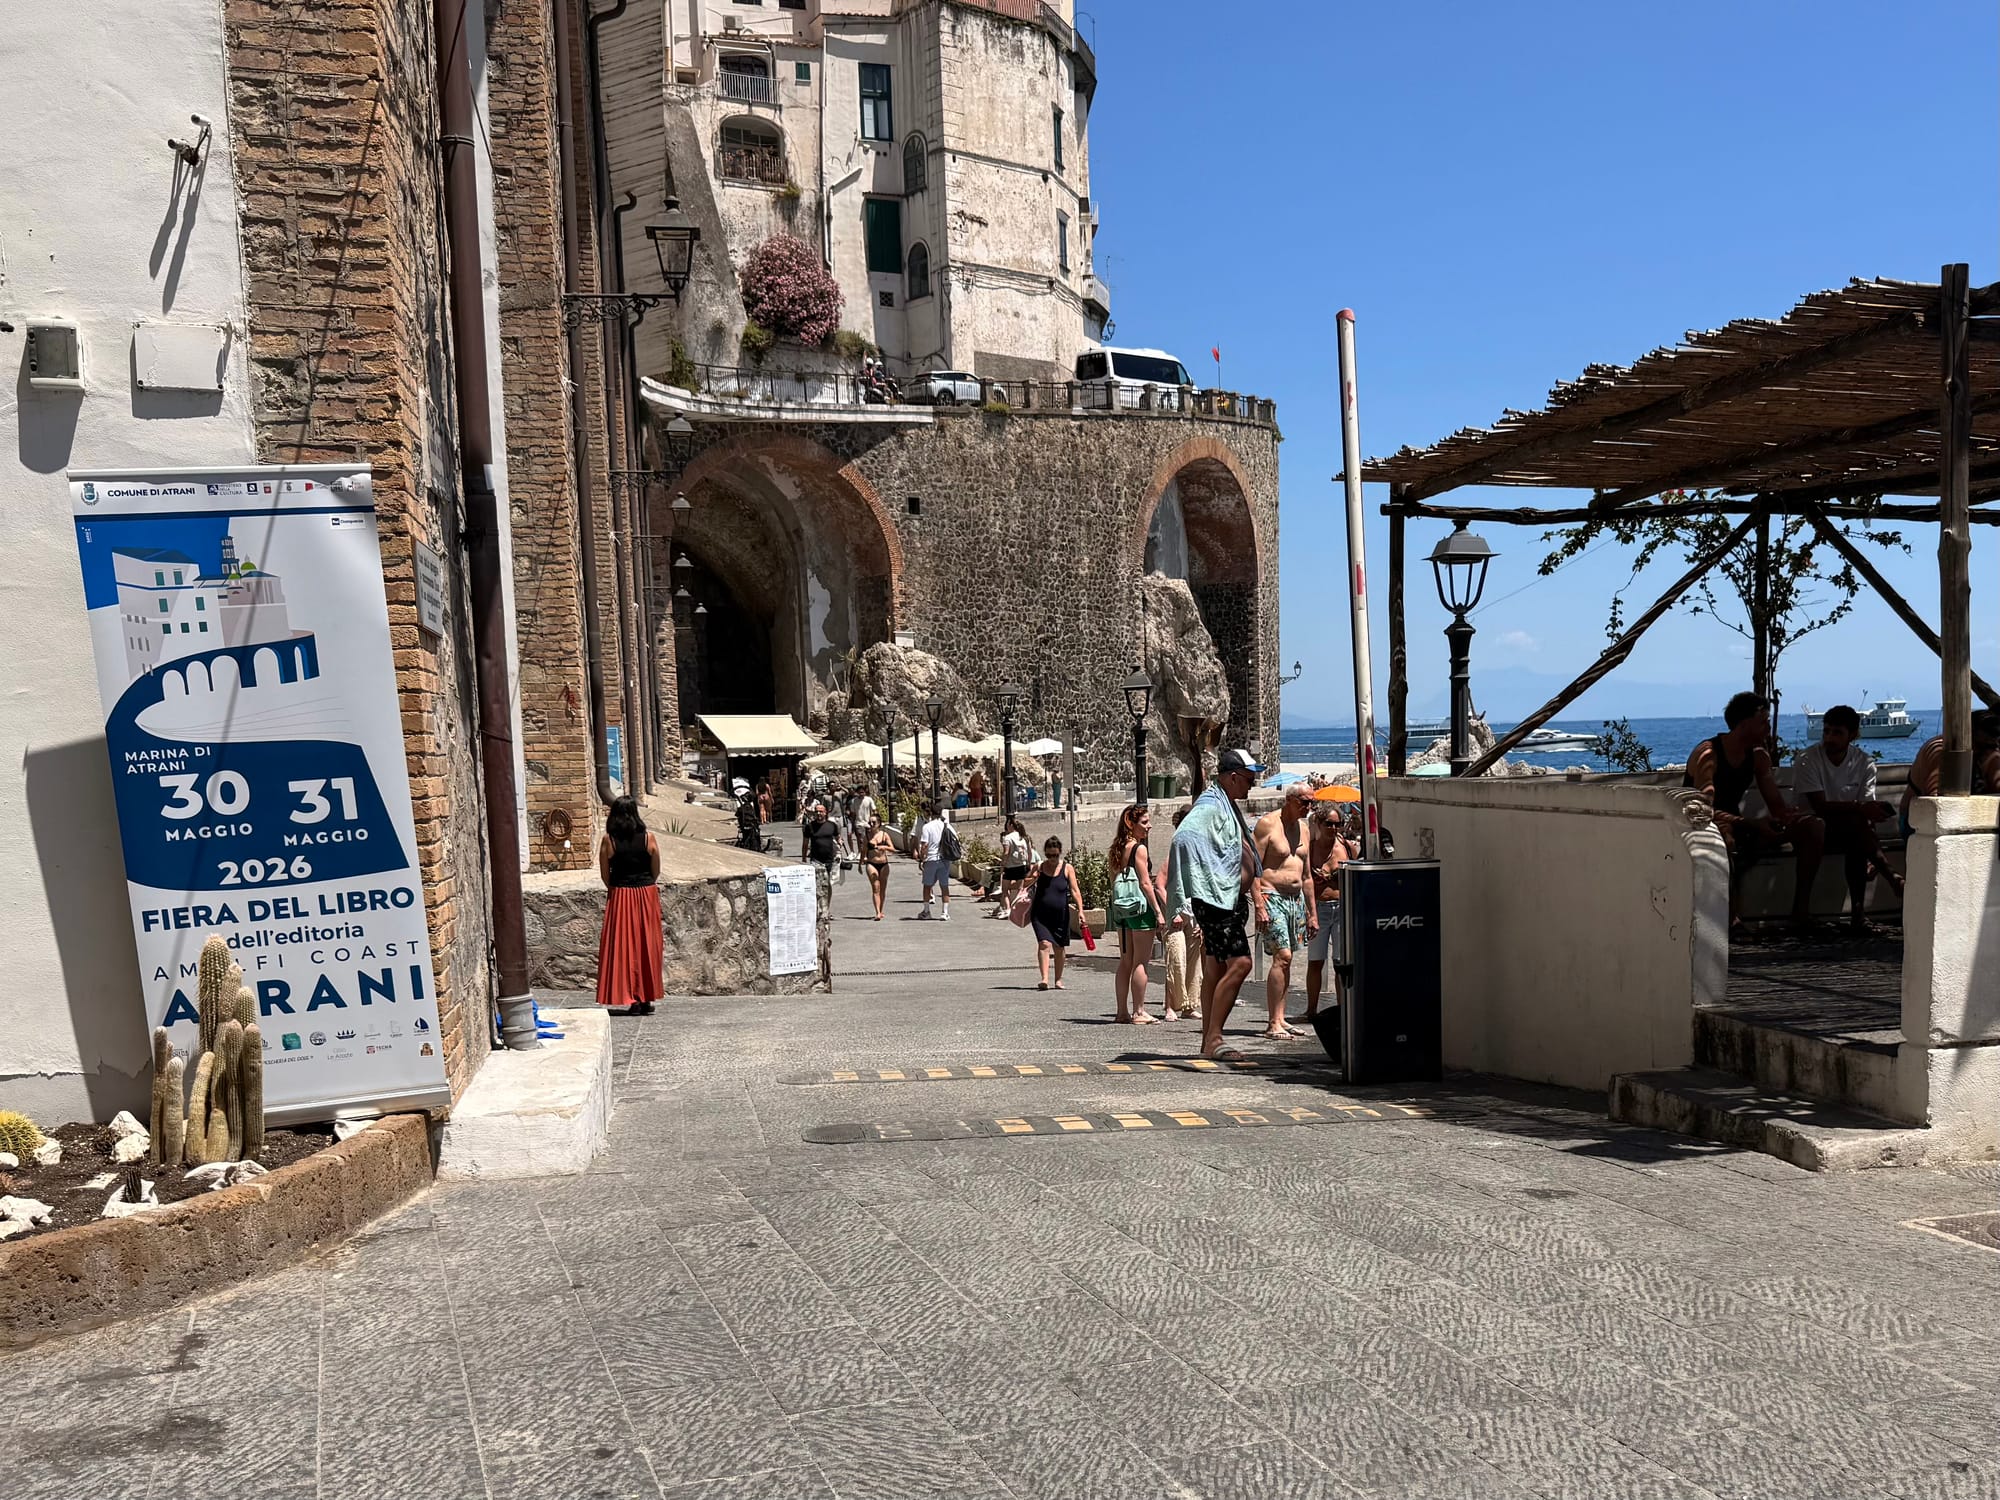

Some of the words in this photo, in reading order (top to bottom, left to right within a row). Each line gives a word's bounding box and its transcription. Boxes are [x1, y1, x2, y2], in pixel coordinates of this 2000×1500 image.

[107, 489, 148, 497] COMUNE
[161, 487, 196, 496] ATRANI
[124, 748, 189, 762] MARINA
[194, 746, 211, 757] DI
[127, 760, 186, 774] ATRANI
[159, 769, 250, 820] 30
[287, 776, 358, 824] 31
[165, 822, 253, 842] MAGGIO
[283, 828, 369, 847] MAGGIO
[217, 855, 312, 886] 2026
[141, 902, 240, 933] FIERA
[247, 896, 310, 922] DEL
[318, 887, 415, 916] LIBRO
[1376, 915, 1424, 930] FAAC
[226, 922, 365, 950] dell'editoria
[153, 953, 283, 982] AMFI
[310, 940, 419, 964] COAST
[162, 964, 425, 1027] ARANI
